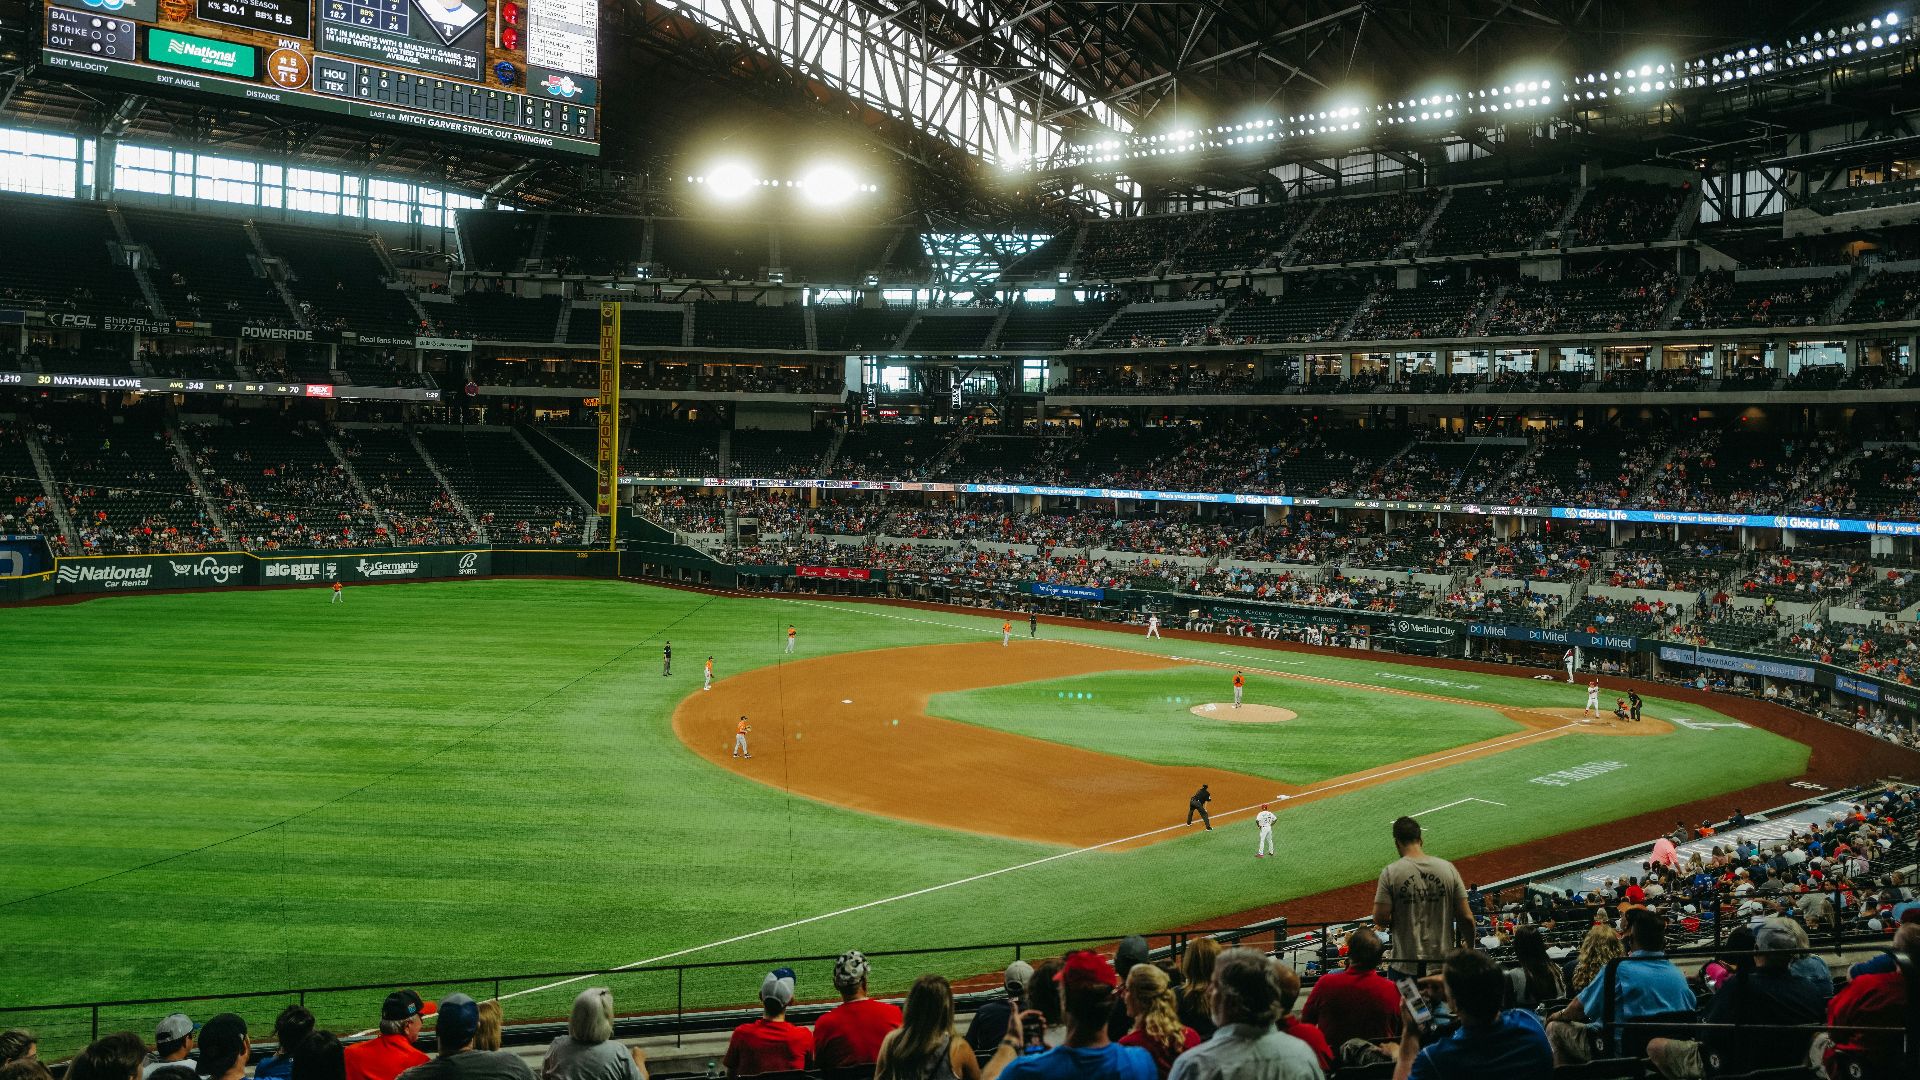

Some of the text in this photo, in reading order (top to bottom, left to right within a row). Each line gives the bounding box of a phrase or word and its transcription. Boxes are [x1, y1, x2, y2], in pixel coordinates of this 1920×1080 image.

[208, 2, 245, 16] K% 30.1
[250, 0, 279, 10] SEASON
[52, 11, 78, 23] BALL
[255, 11, 292, 25] BB% 5.5
[330, 10, 346, 19] 18.7
[360, 8, 374, 18] BB%
[52, 24, 88, 36] STRIKE
[443, 24, 453, 36] T
[52, 36, 74, 46] OUT
[278, 38, 300, 50] MVR
[325, 27, 338, 35] 1ST
[349, 32, 378, 43] MAJORS
[379, 38, 397, 46] WITH
[404, 43, 436, 54] MULTI-HIT
[438, 50, 462, 60] GAMES,
[183, 43, 236, 62] National
[336, 36, 351, 44] HITS
[353, 39, 371, 48] WITH
[382, 45, 398, 54] AND
[416, 52, 429, 60] FOR
[444, 58, 461, 66] WITH
[214, 59, 233, 68] Rental
[290, 58, 296, 67] 5
[386, 52, 420, 64] AVERAGE.
[50, 57, 108, 73] EXIT VELOCITY
[157, 75, 200, 88] EXIT ANGLE
[279, 71, 287, 82] T
[324, 69, 346, 80] HOU
[362, 76, 368, 84] 0
[381, 80, 387, 88] 0
[325, 81, 344, 91] TEX
[246, 90, 280, 101] DISTANCE
[399, 114, 426, 125] MITCH
[428, 119, 460, 131] GARVER
[462, 125, 494, 136] STRUCK
[495, 130, 512, 139] OUT
[513, 134, 552, 146] SWINGING
[62, 314, 97, 326] PGL
[104, 316, 170, 327] ShipPGL.com
[104, 324, 170, 333] 877.701.1919
[242, 326, 313, 340] POWERADE
[392, 338, 413, 346] know.
[602, 326, 612, 359] THE
[38, 376, 141, 388] 30 NATHANIEL LOWE
[186, 382, 204, 390] .343
[289, 386, 299, 394] 70
[602, 370, 611, 403] HOT
[601, 414, 610, 460] ZONE
[1246, 495, 1282, 504] Globe Life
[1579, 509, 1627, 520] Globe Life
[1653, 513, 1676, 521] Who's
[1698, 514, 1746, 524] beneficiary?
[1790, 519, 1840, 530] Globe Life
[1867, 523, 1893, 531] Who's
[1896, 525, 1913, 533] your
[375, 561, 418, 570] Germania
[459, 553, 477, 569] B
[80, 565, 152, 580] National
[194, 556, 244, 583] Kroger
[266, 562, 320, 577] BIG BITE
[1410, 623, 1455, 636] Medical City
[1483, 626, 1506, 637] Mitel
[1542, 631, 1568, 642] Mitel
[1605, 636, 1632, 648] Mitel
[1705, 657, 1718, 665] WAY
[1762, 665, 1794, 675] TONIGHT
[1885, 694, 1897, 703] Globe
[1898, 698, 1906, 706] Life
